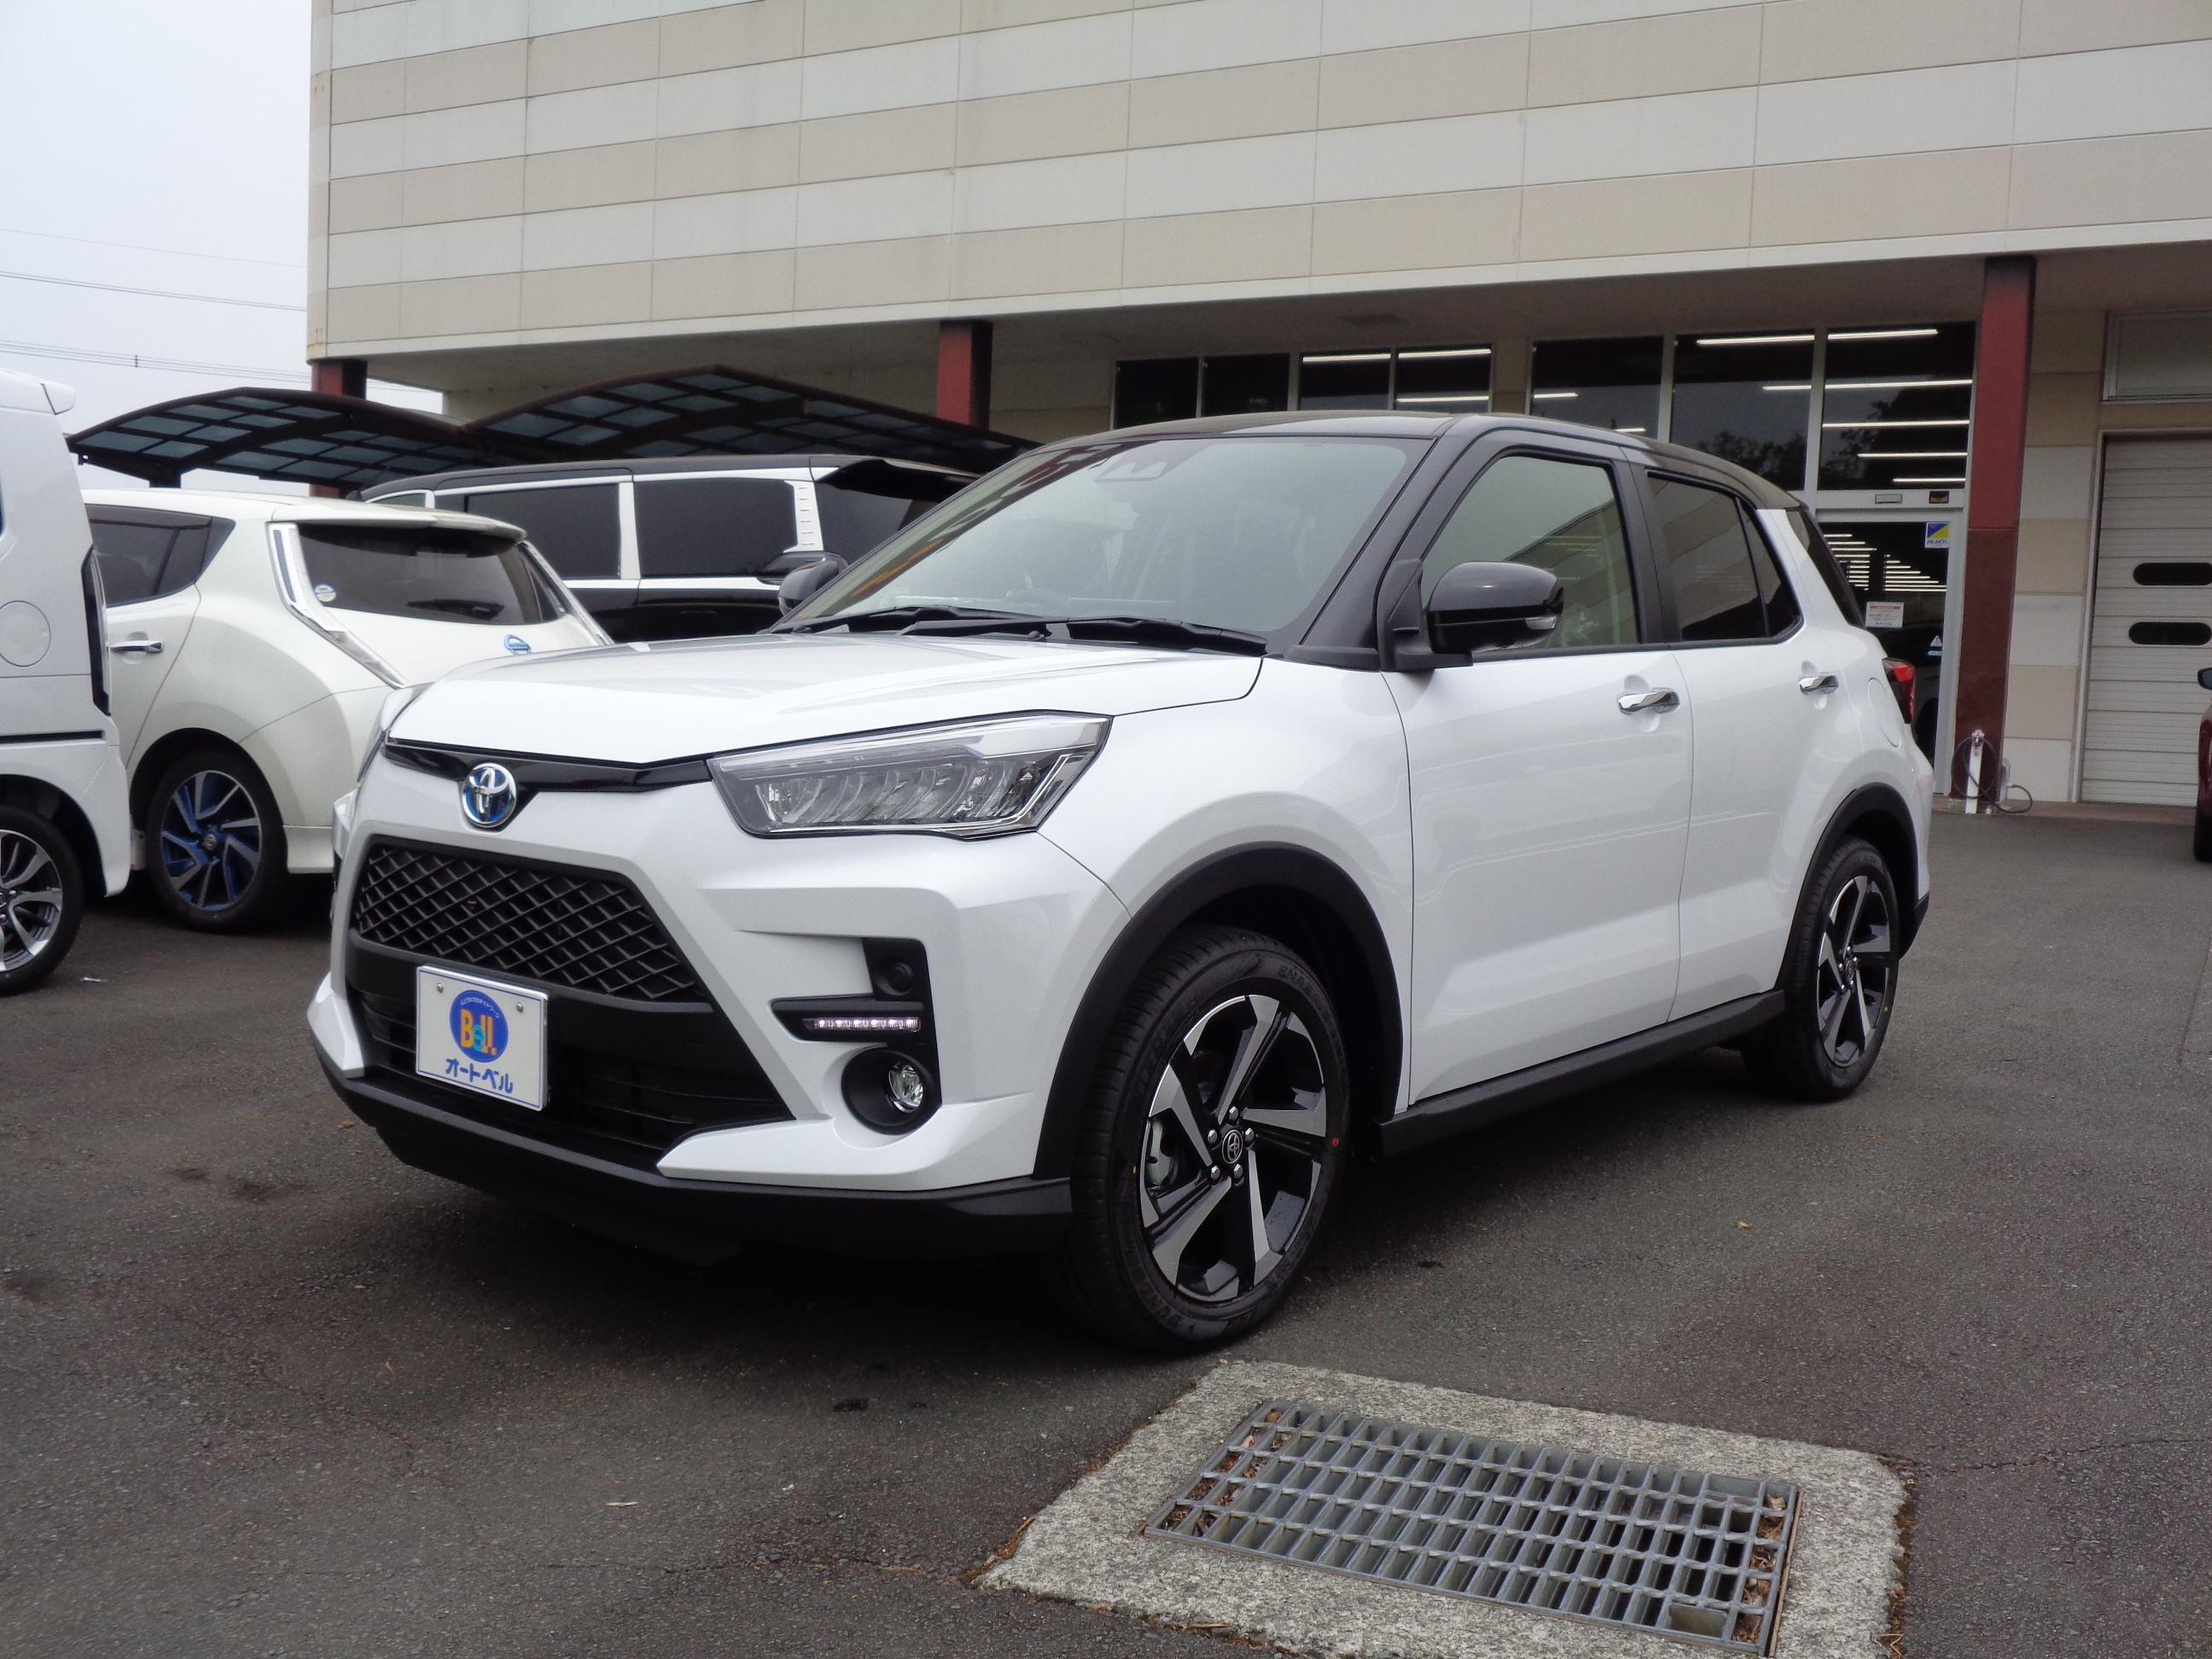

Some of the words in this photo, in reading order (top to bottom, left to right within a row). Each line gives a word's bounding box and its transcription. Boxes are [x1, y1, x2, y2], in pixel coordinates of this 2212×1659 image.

[445, 1057, 514, 1094] オートベル
